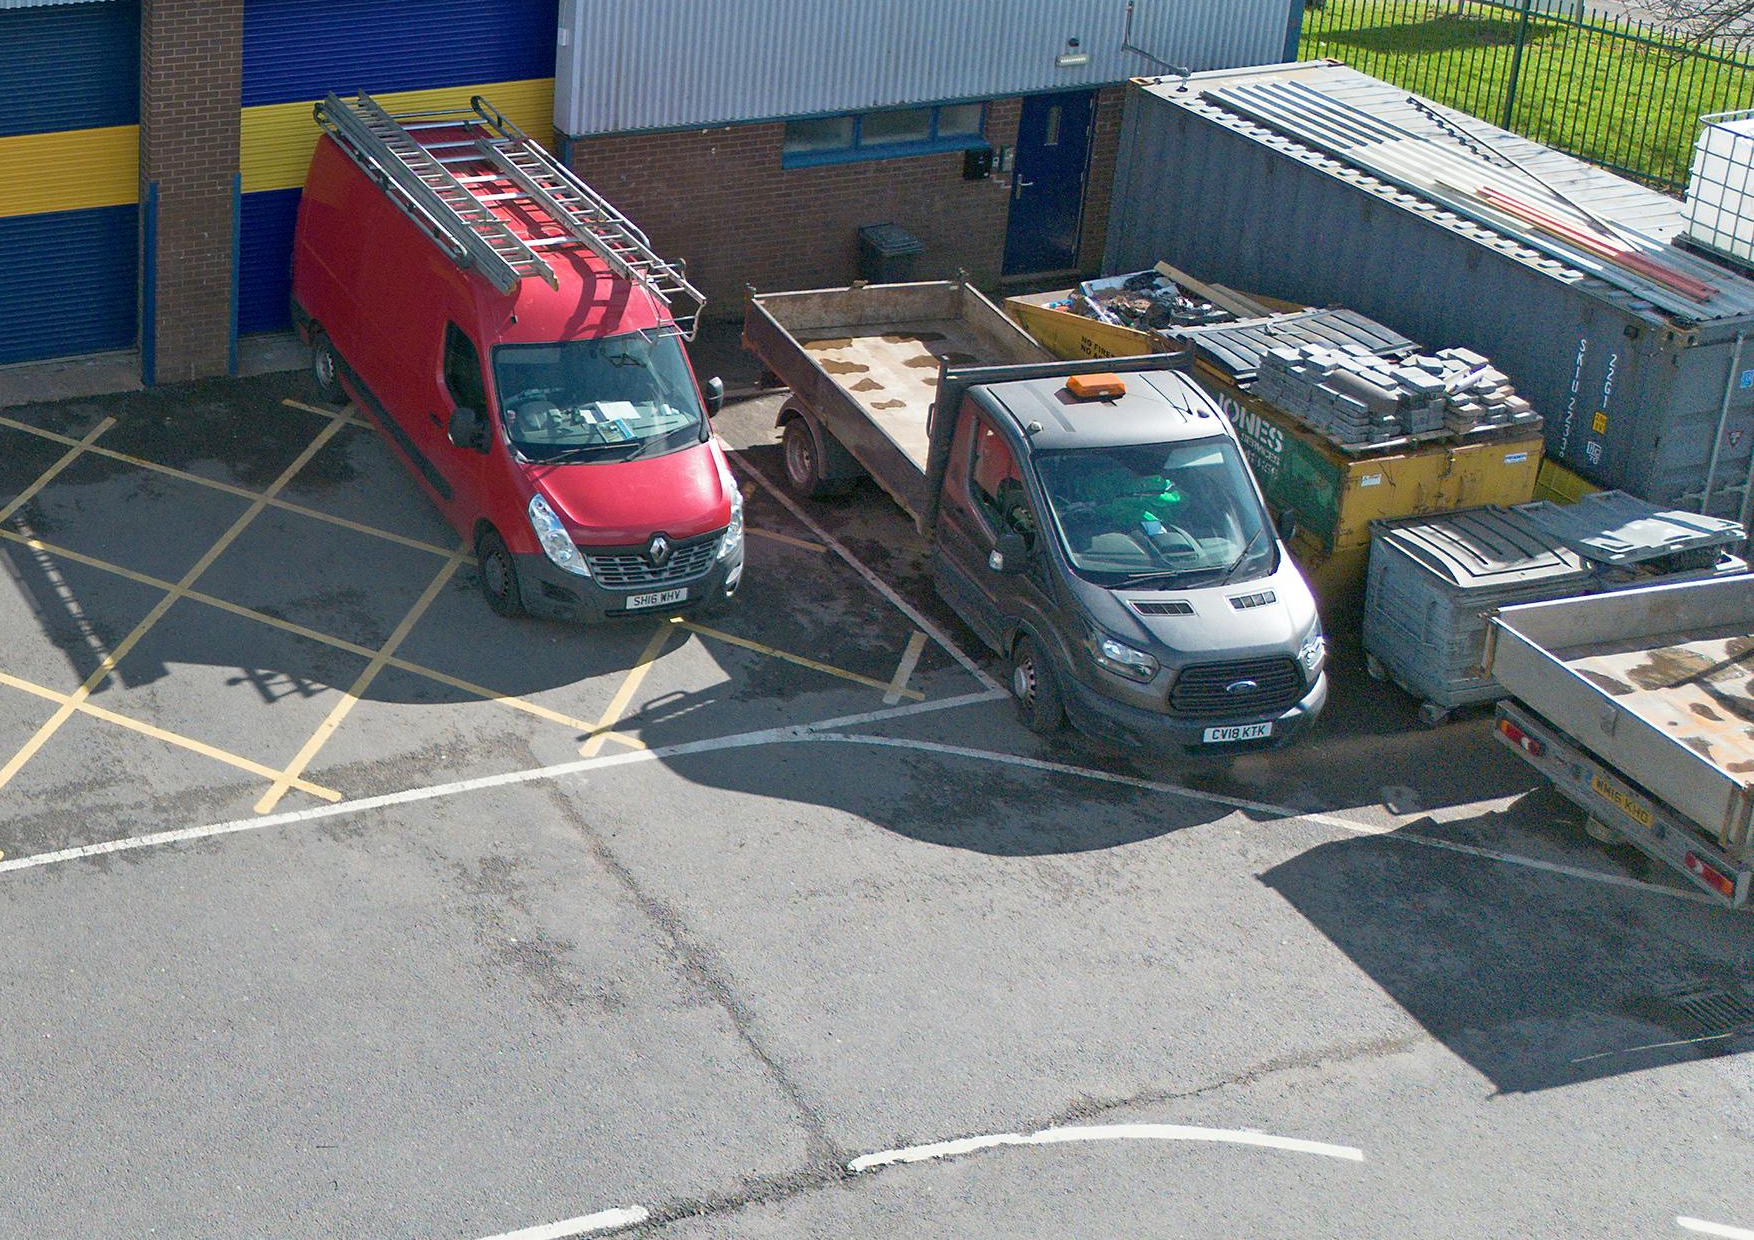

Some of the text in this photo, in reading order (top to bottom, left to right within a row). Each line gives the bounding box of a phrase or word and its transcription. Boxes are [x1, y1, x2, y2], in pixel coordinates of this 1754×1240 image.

[1080, 344, 1092, 355] NO
[1081, 336, 1114, 358] NO FIRE
[633, 594, 658, 607] SH16
[1212, 724, 1266, 740] CV18 KTK
